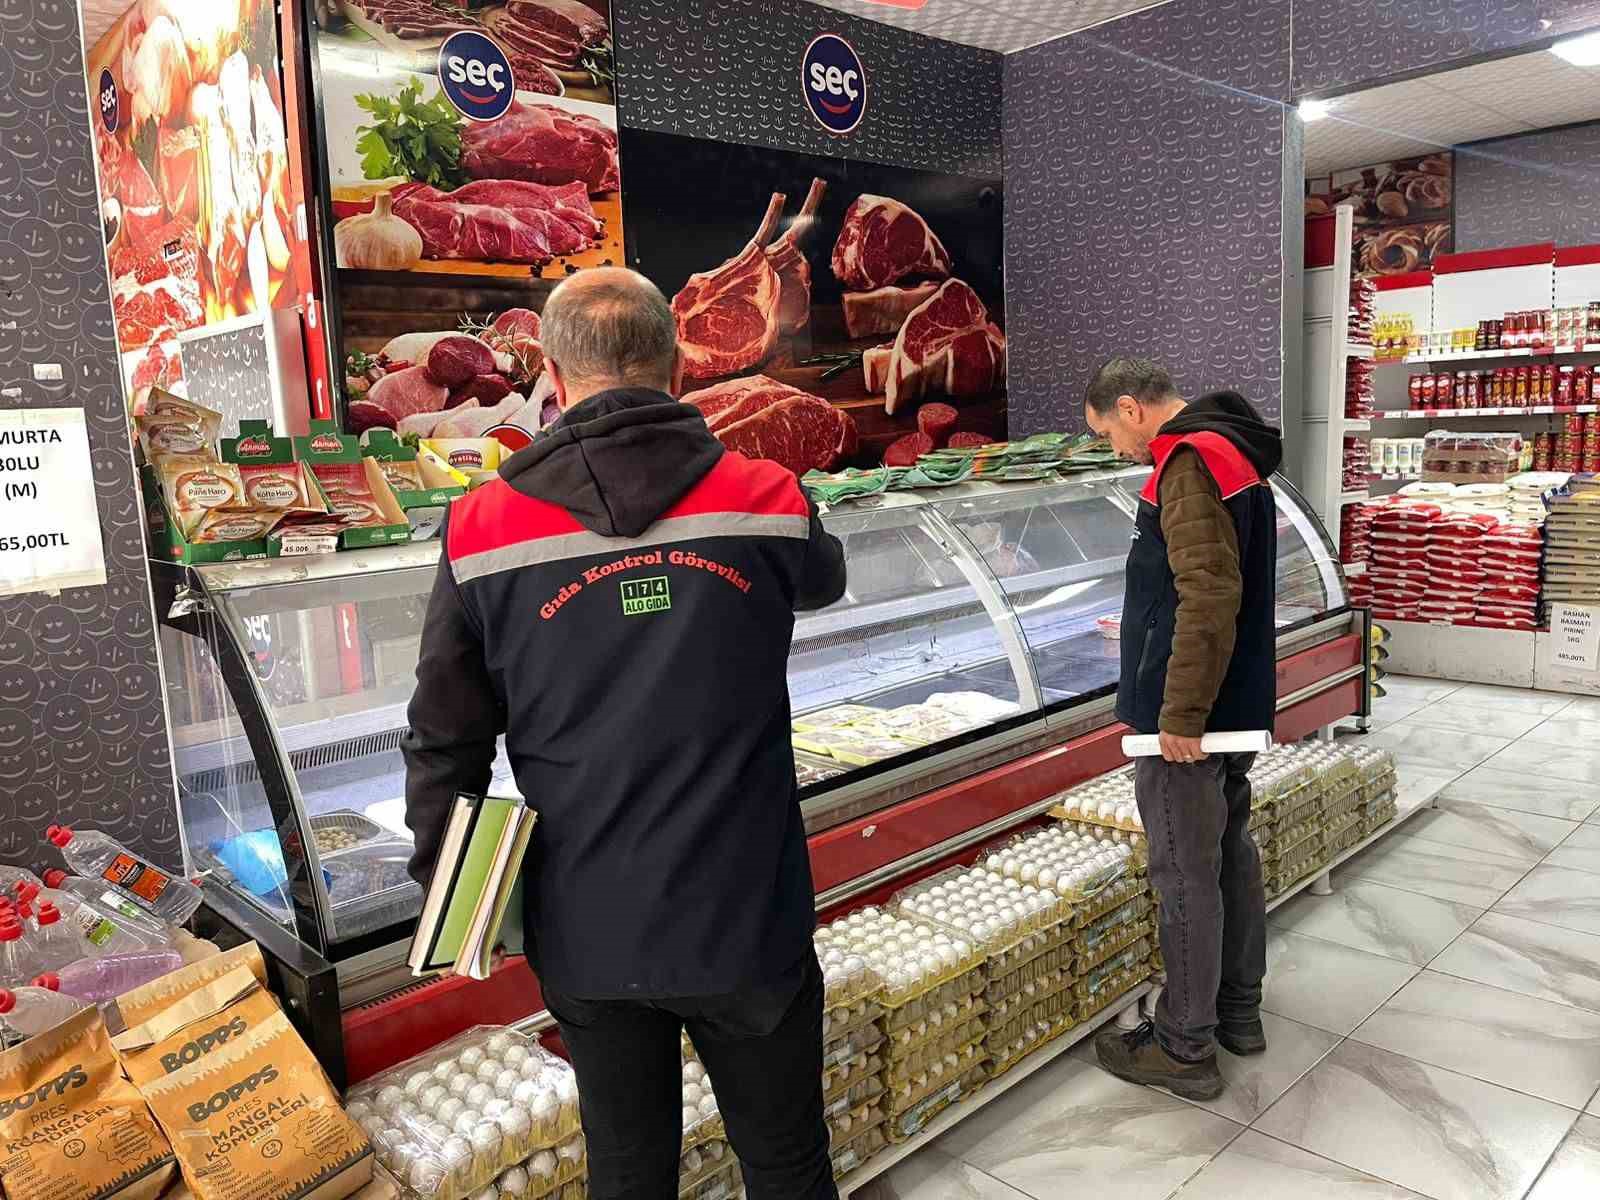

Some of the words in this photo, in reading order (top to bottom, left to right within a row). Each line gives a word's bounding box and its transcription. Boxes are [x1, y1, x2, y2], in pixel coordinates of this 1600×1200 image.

[448, 54, 505, 91] seç
[810, 63, 858, 101] seç
[5, 481, 37, 501] (M)
[539, 580, 582, 620] Gıda
[581, 551, 662, 585] Kontrol
[627, 581, 663, 597] 174
[625, 600, 644, 614] ALO
[646, 597, 669, 610] GIDA
[161, 1016, 247, 1073] BOPPS
[187, 1064, 279, 1122] BOPPS
[227, 1096, 262, 1121] PRES
[31, 1104, 68, 1127] PRES
[211, 1096, 289, 1145] MANGAL
